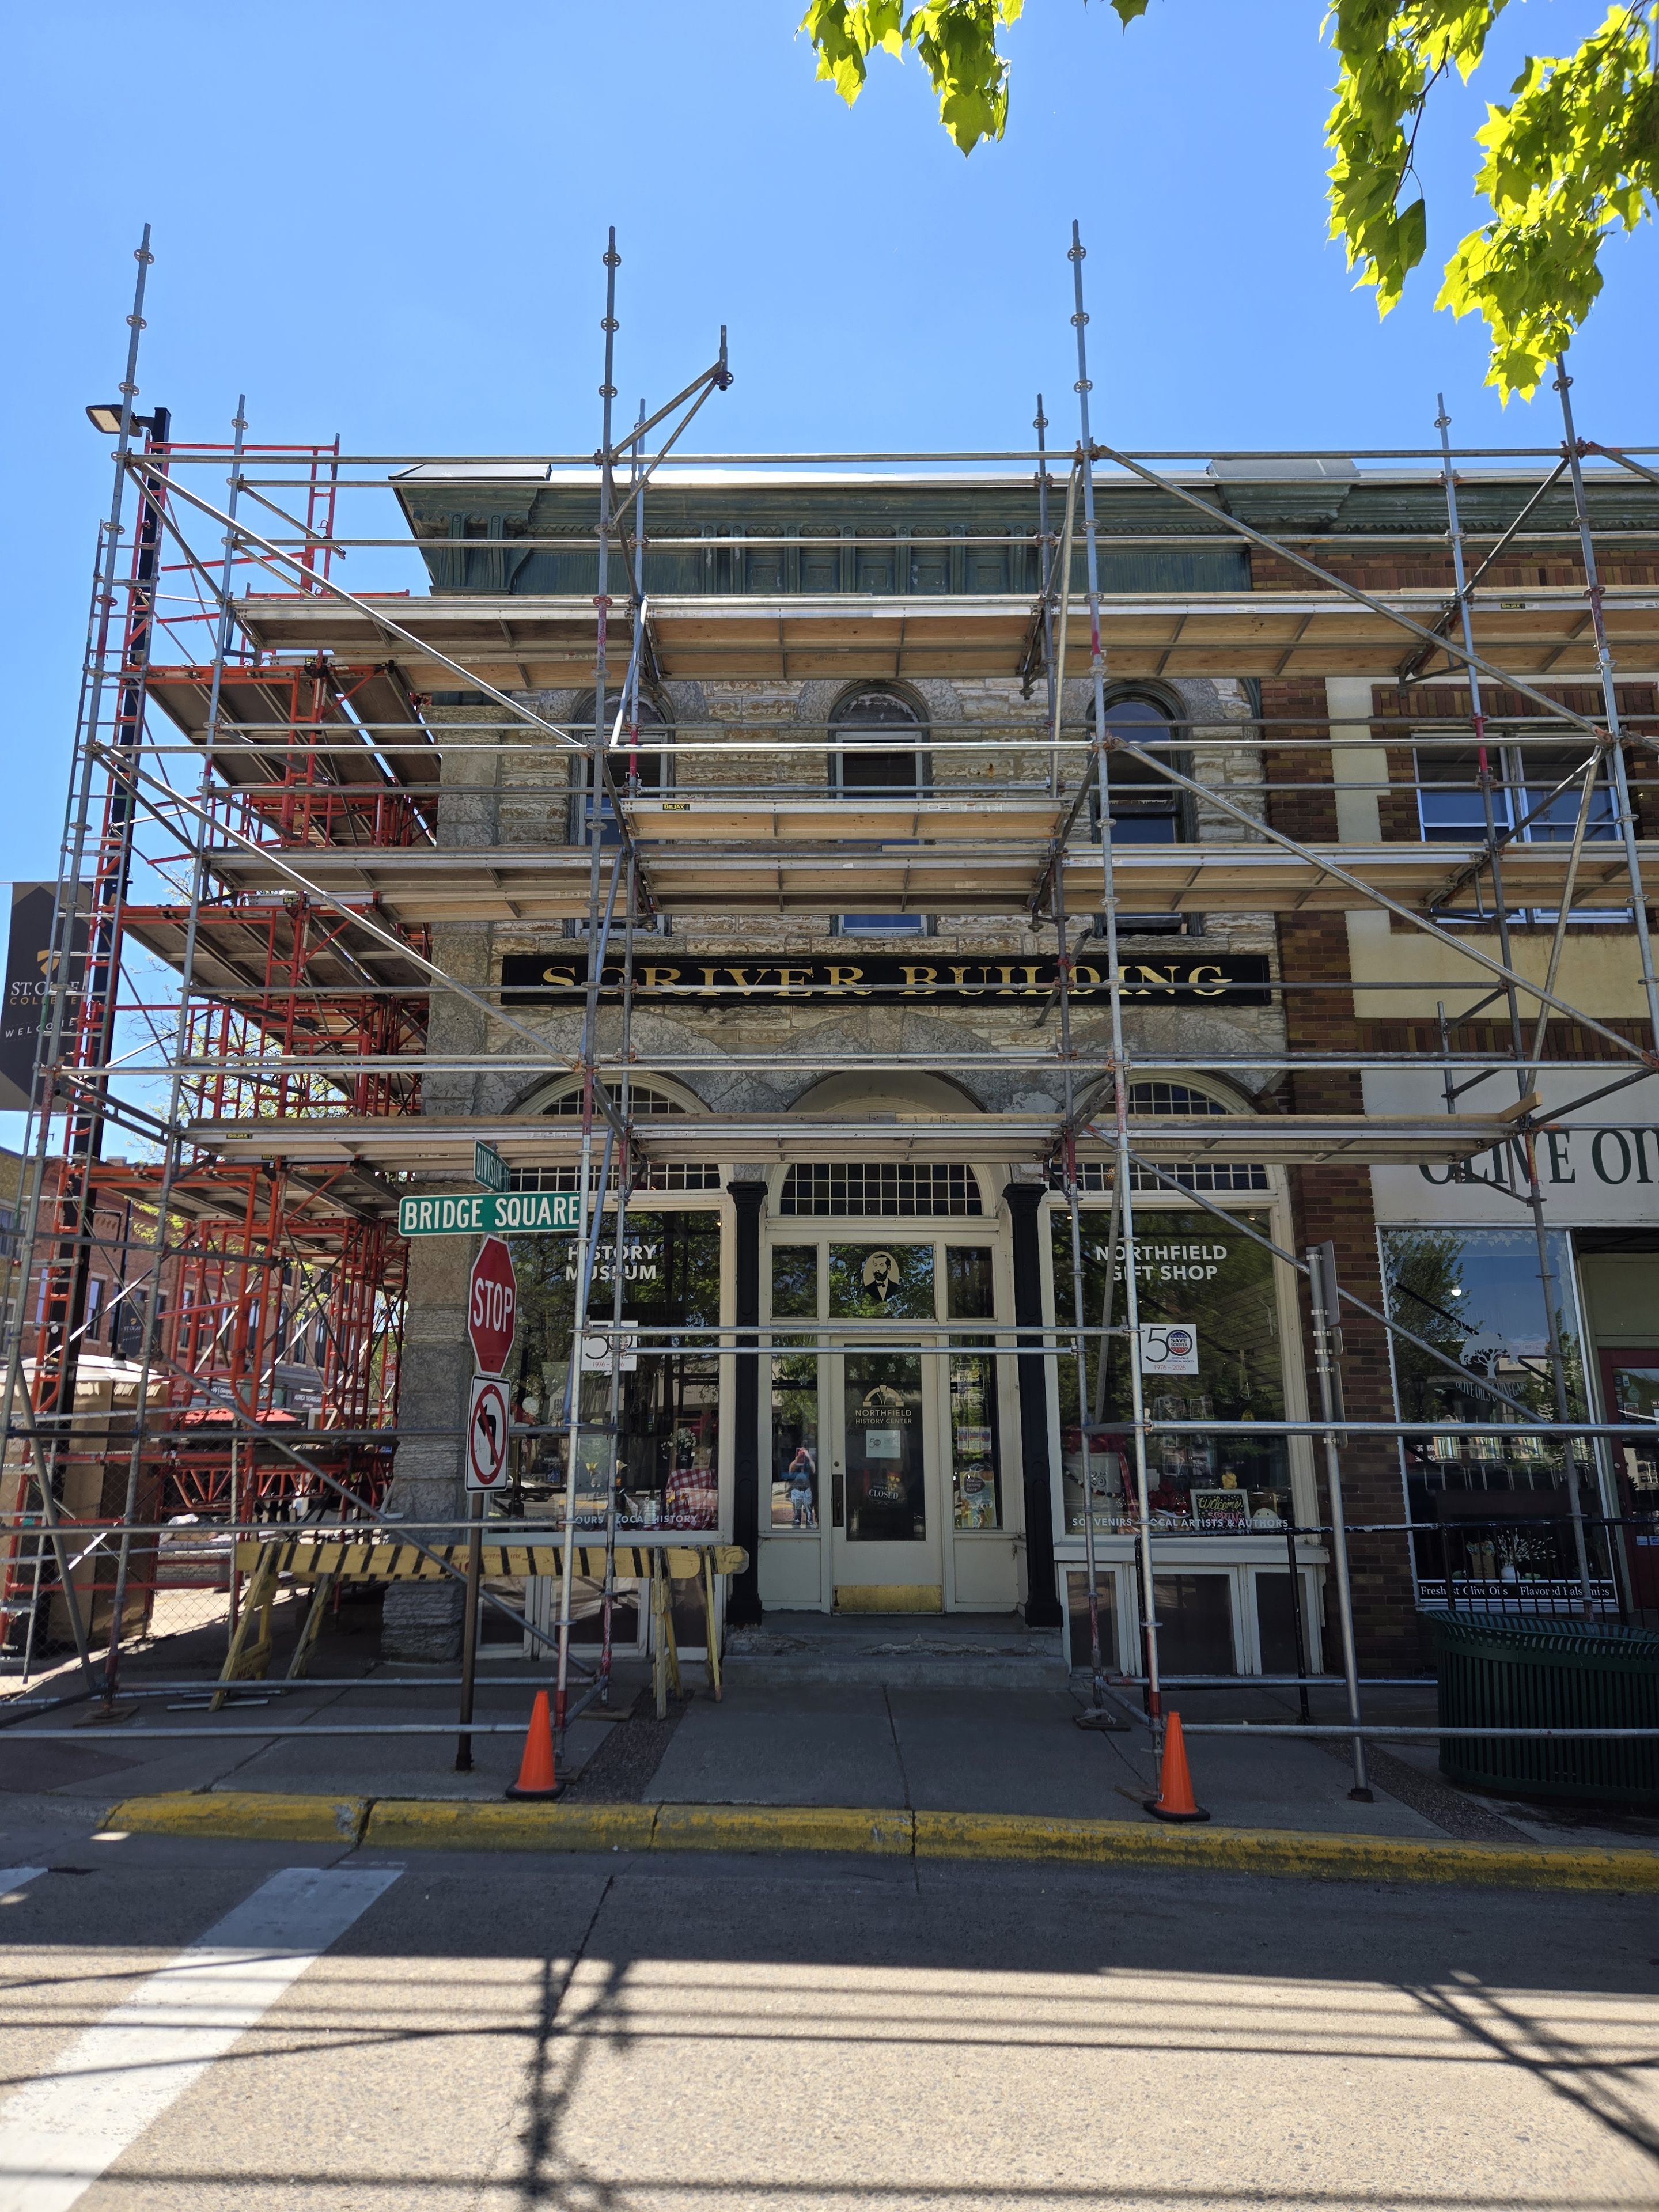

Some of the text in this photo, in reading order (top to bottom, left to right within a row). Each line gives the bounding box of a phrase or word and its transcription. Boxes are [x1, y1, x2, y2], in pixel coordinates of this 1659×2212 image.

[34, 981, 79, 995] OF
[541, 965, 1232, 997] SCRIVER BUILDING
[5, 1018, 74, 1038] WELCOE
[1592, 1130, 1659, 1184] OI
[476, 1147, 502, 1188] DIVISION
[404, 1196, 580, 1231] BRIDGE SQUARE
[1096, 1245, 1228, 1260] NORTHFIELD
[1161, 1265, 1218, 1281] SHOP
[473, 1276, 513, 1333] STOP
[1145, 1327, 1193, 1363] 50
[869, 1488, 899, 1499] CLOSED
[1072, 1518, 1289, 1528] SOVENIRS OCAL ARTISTS & AUTHORS
[1421, 1586, 1460, 1595] Freshst
[1489, 1586, 1508, 1595] Ois
